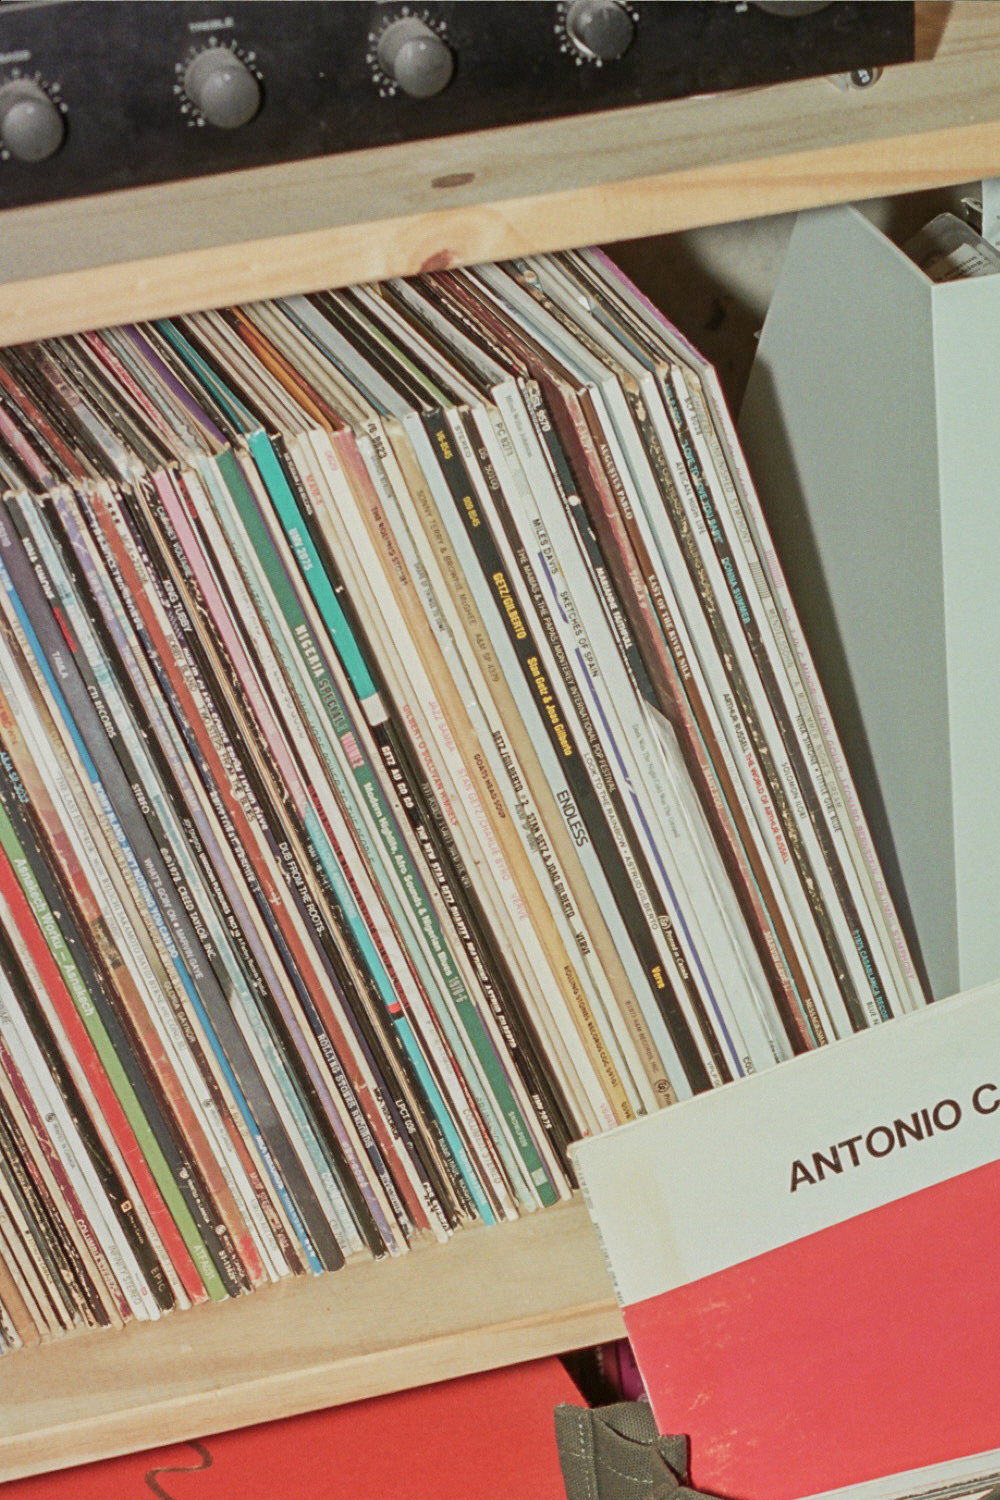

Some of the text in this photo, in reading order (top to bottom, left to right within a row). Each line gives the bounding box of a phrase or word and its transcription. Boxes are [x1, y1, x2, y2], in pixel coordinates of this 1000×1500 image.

[686, 464, 700, 478] TO
[672, 460, 707, 536] AFRICAN HIGH LIFE
[690, 476, 709, 502] LOVE
[699, 499, 715, 518] YOU
[513, 546, 529, 565] THE
[595, 442, 693, 681] AUGUSTUS PABLO EAST OF THE RIVER NILE
[719, 556, 738, 584] DONNA
[519, 563, 539, 592] MAMAS
[160, 578, 194, 634] KING TUBBY
[488, 571, 529, 641] GETZ/GILBERTO
[528, 517, 601, 679] MILES DAVIS SKETCHES OF SPAIN
[534, 600, 548, 616] THE
[593, 566, 635, 650] MARIANNE FAITHFULL
[728, 583, 753, 624] SUMMER
[291, 623, 347, 726] NIGERIA SPECIAL
[525, 656, 542, 677] Stan
[532, 675, 550, 696] Getz
[92, 700, 117, 739] RECORDS
[543, 702, 561, 725] Joao
[565, 684, 601, 744] INTERNATIONAL
[720, 691, 740, 722] ARTHUR
[550, 722, 575, 757] Gilberto
[589, 742, 605, 760] POP
[731, 722, 751, 754] RUSSELL
[742, 752, 756, 767] THE
[379, 743, 414, 810] GETZ AU GO GO
[470, 752, 507, 821] GOATS HEAD SOUP
[596, 759, 618, 793] FESTIVAL
[747, 765, 767, 795] WORLD
[360, 781, 385, 818] Modern
[757, 794, 769, 805] OF
[553, 788, 591, 849] ENDLESS
[761, 804, 780, 835] ARTHUR
[276, 841, 293, 862] DUB
[392, 852, 411, 876] Afro
[772, 834, 792, 865] RUSSELL
[90, 780, 113, 813] BOBBY
[104, 811, 127, 843] BLAND
[129, 867, 157, 908] NOTHING
[147, 906, 164, 927] YOU
[156, 925, 173, 945] CAN
[165, 943, 179, 960] DO
[284, 860, 305, 887] FROM
[296, 885, 312, 903] THE
[401, 873, 425, 909] Sounds
[141, 856, 163, 888] WHAT'S
[165, 908, 178, 922] ON
[173, 927, 196, 960] MARVIN
[187, 958, 205, 980] GAYE
[417, 914, 444, 953] Nigerian
[10, 854, 98, 1018] Asnakech Worku Asnakech
[435, 950, 455, 977] Blues
[648, 964, 669, 991] Verve
[790, 1099, 962, 1193] ANTONIO
[190, 1242, 217, 1281] ATFA031
[147, 1265, 170, 1293] EPIC
